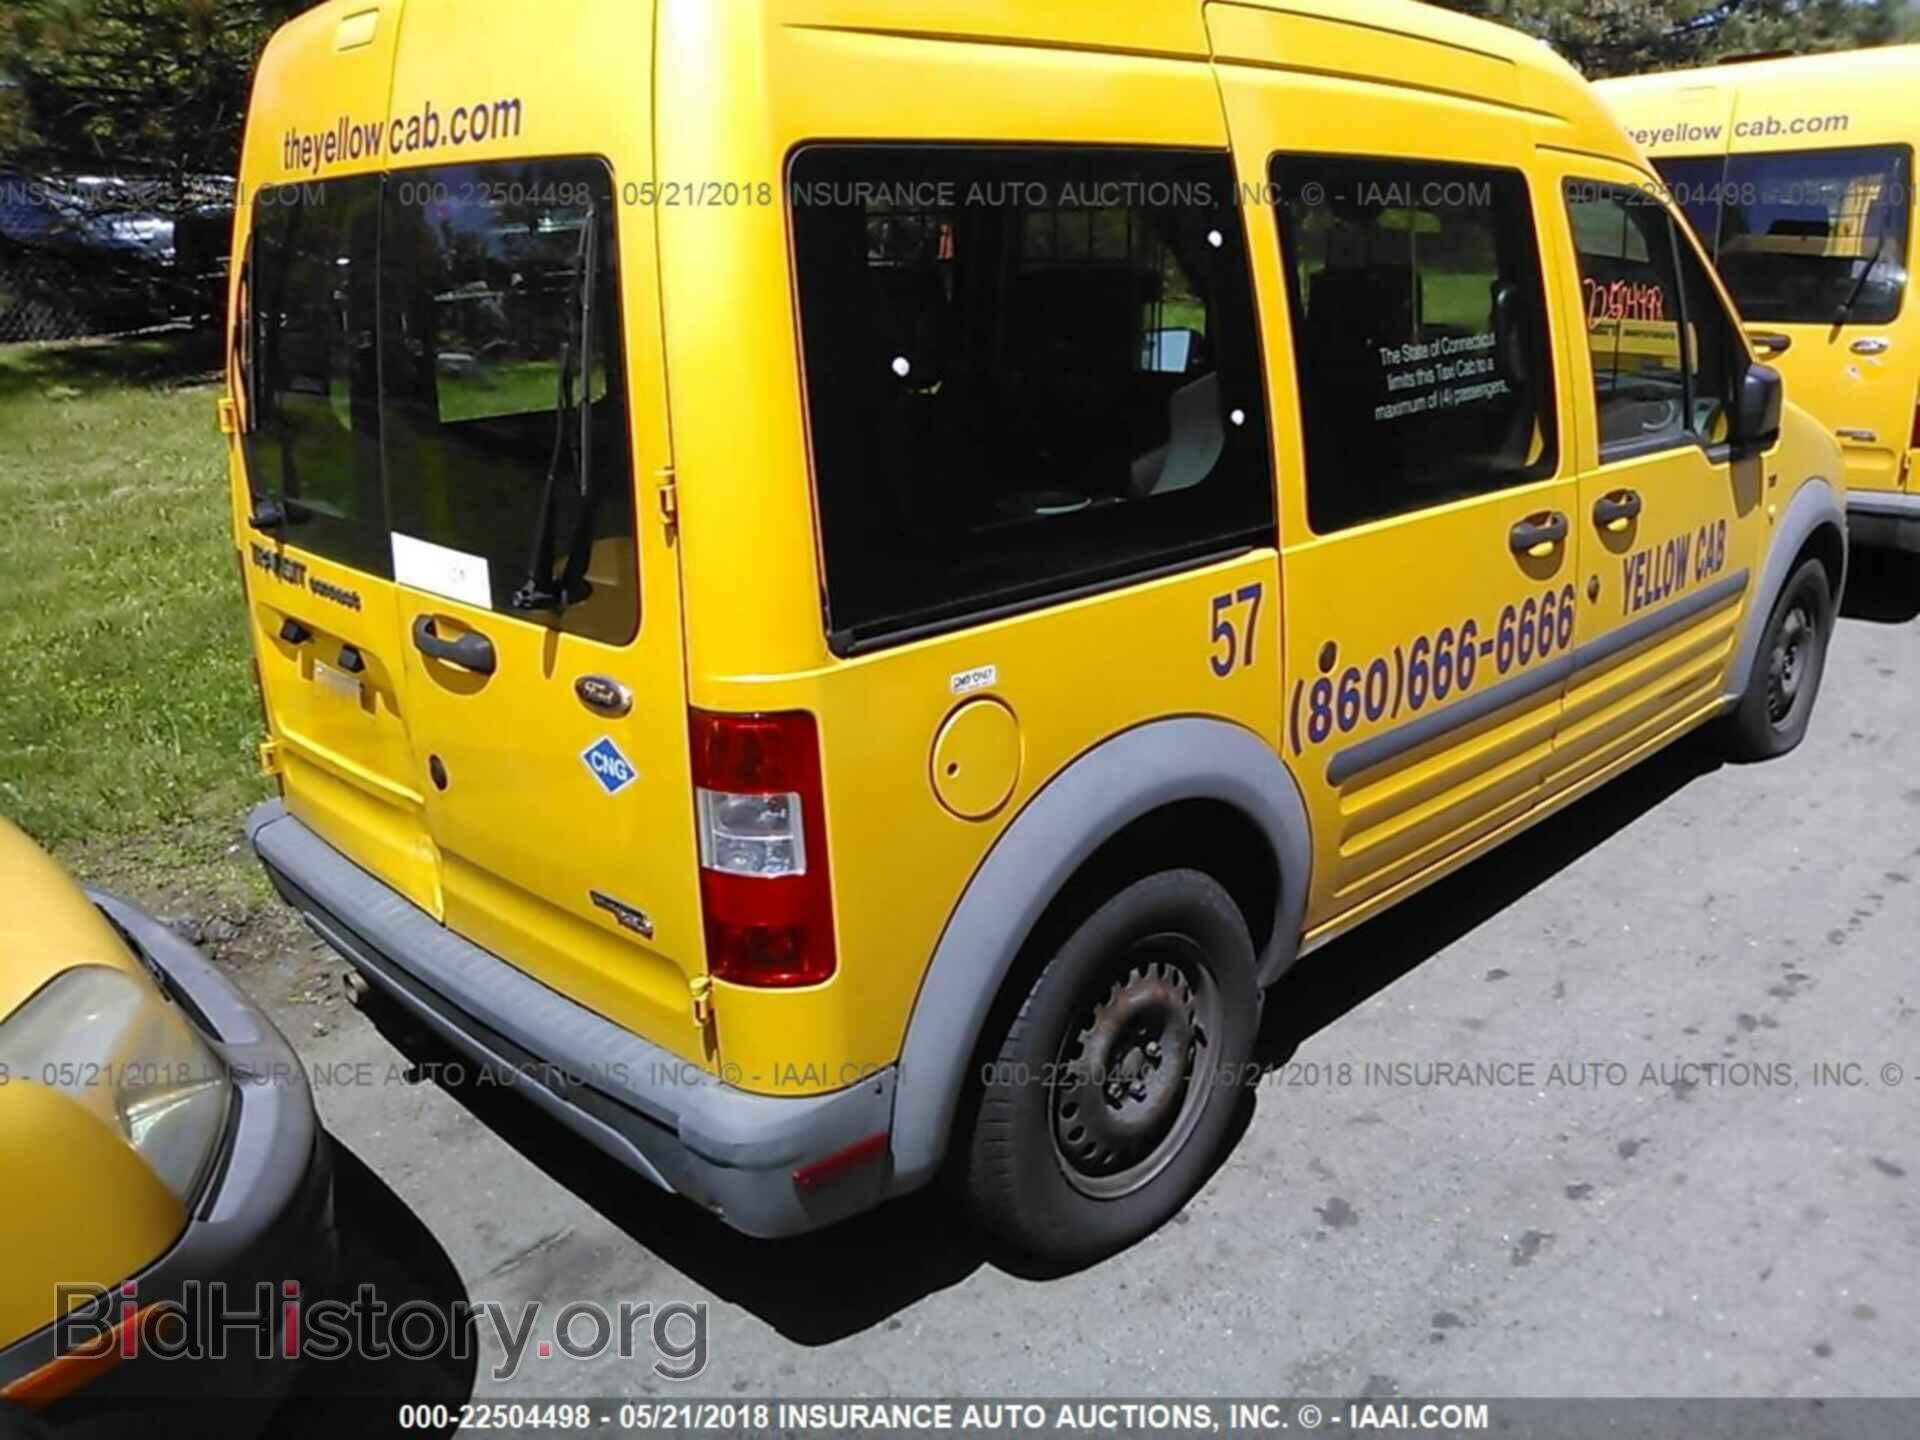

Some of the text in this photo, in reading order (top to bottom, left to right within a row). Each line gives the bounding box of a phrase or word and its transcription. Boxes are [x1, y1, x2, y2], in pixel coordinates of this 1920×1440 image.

[283, 97, 522, 174] theyellow cab.com
[1628, 113, 1849, 148] eyellow cab.com
[1379, 346, 1401, 366] The
[1622, 519, 1727, 617] YELLOW CAB
[1210, 581, 1263, 678] 57
[1289, 582, 1576, 757] (860)666-6666
[590, 750, 628, 781] CNG
